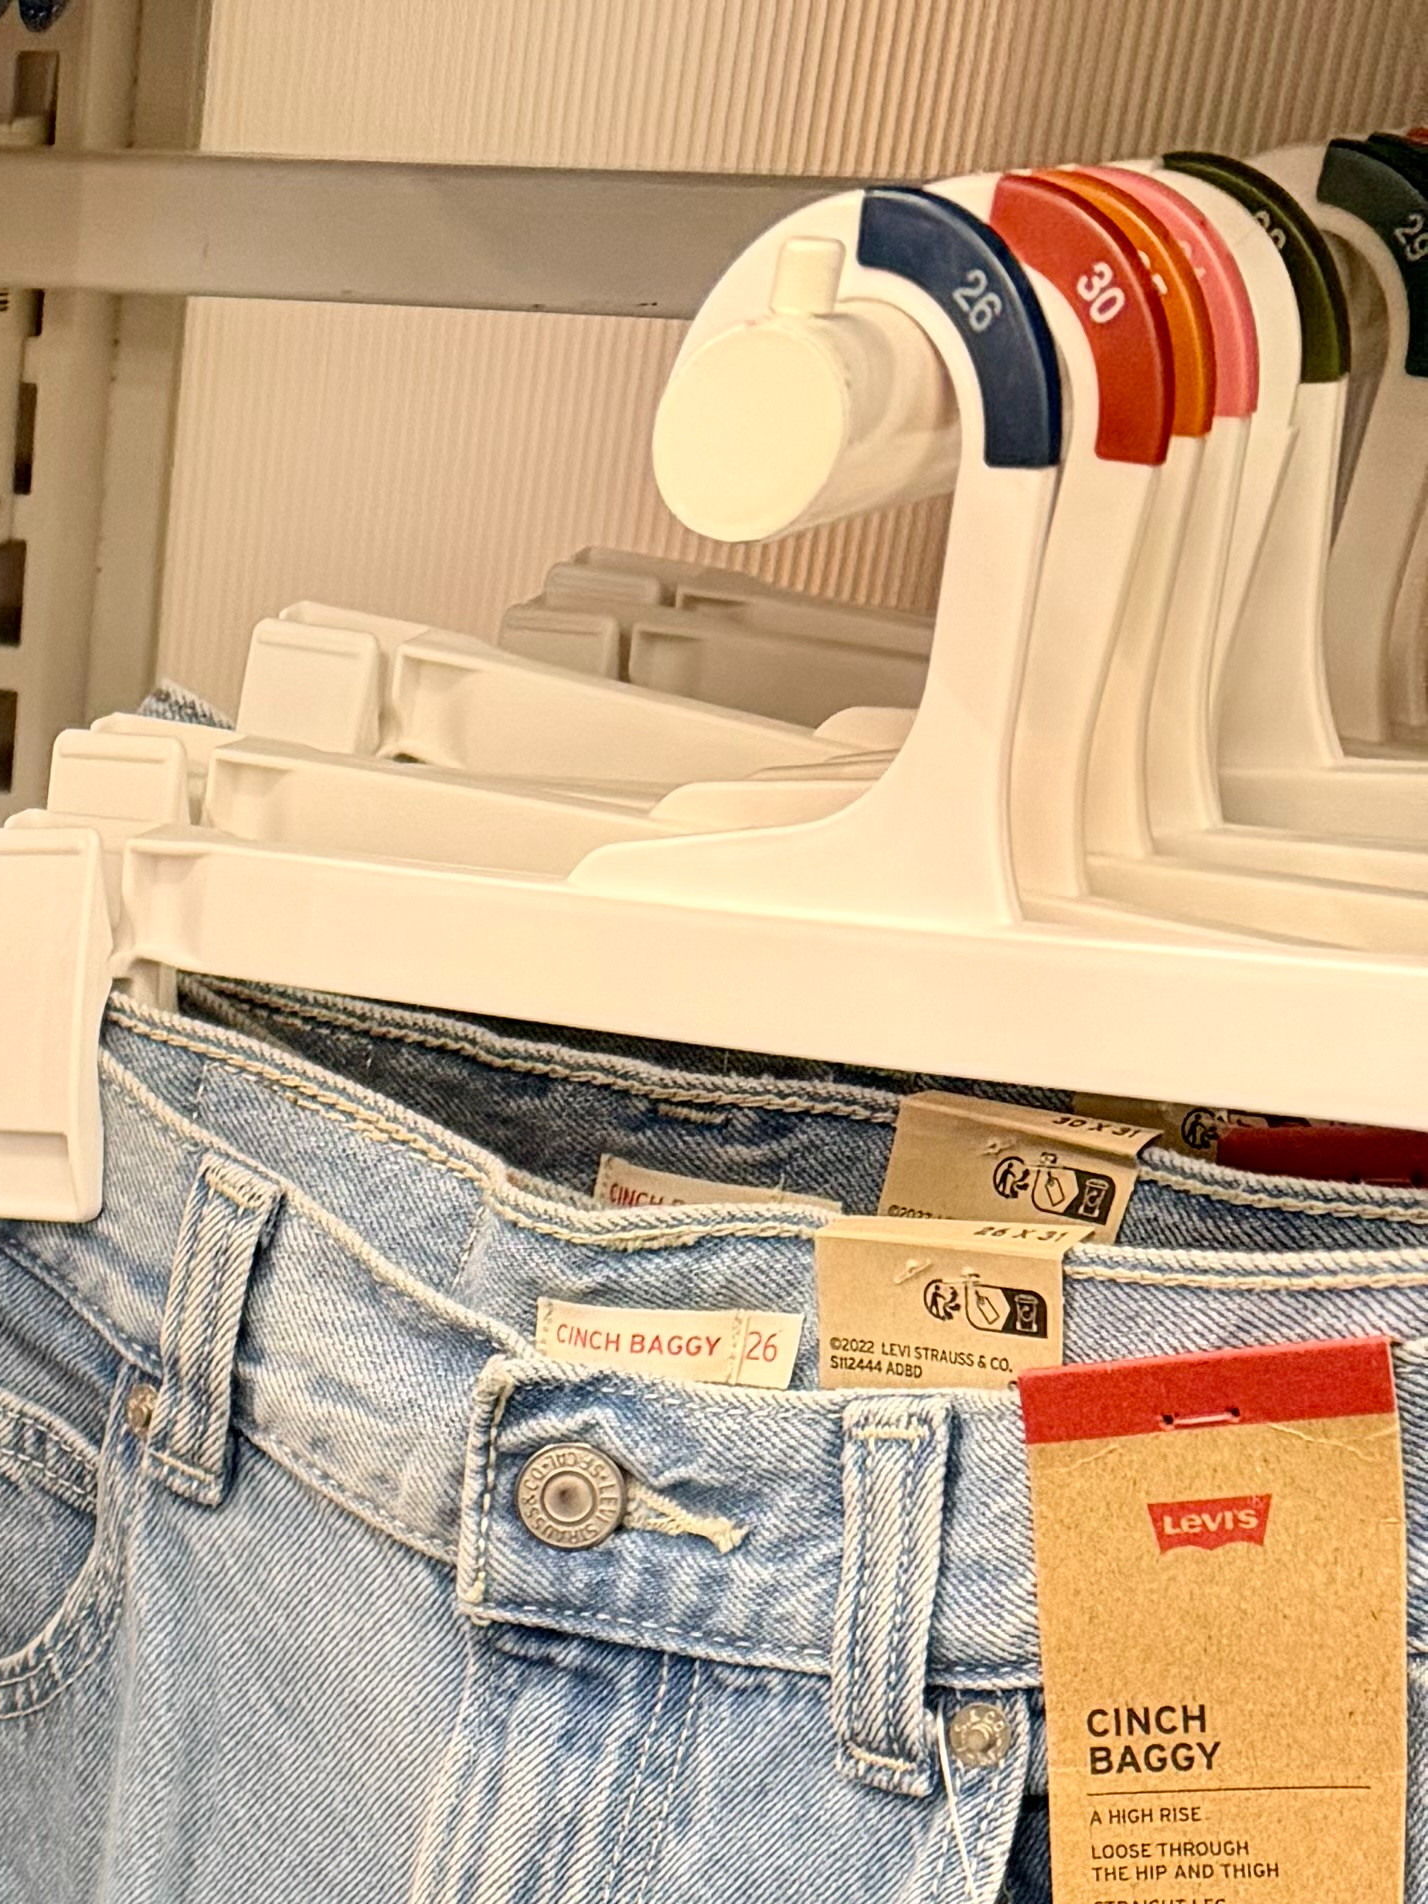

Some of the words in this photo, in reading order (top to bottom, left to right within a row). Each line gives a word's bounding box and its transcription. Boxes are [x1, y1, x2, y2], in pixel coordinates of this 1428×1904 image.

[952, 269, 1003, 333] 26
[1076, 261, 1126, 324] 30
[1051, 1117, 1087, 1128] 30
[1112, 1127, 1142, 1138] 31
[556, 1323, 621, 1353] CINCH
[630, 1333, 722, 1356] BAGGY
[745, 1331, 781, 1362] 26
[881, 1342, 910, 1358] LEVI
[914, 1347, 974, 1367] STRAUSS
[977, 1355, 987, 1369] &
[990, 1357, 1013, 1373] CO.
[830, 1355, 882, 1373] S112444
[886, 1362, 923, 1378] ADBD
[1086, 1704, 1207, 1738] CINCH
[1089, 1741, 1221, 1775] BAGGY
[1090, 1810, 1102, 1826] A
[1109, 1808, 1154, 1825] HIGH
[1159, 1806, 1202, 1822] RISE
[1091, 1842, 1152, 1860] LOOSE
[1157, 1840, 1250, 1858] THROUGH
[1091, 1865, 1129, 1882] THE
[1136, 1864, 1168, 1881] HIP
[1174, 1863, 1215, 1879] AND
[1220, 1862, 1280, 1879] THIGH
